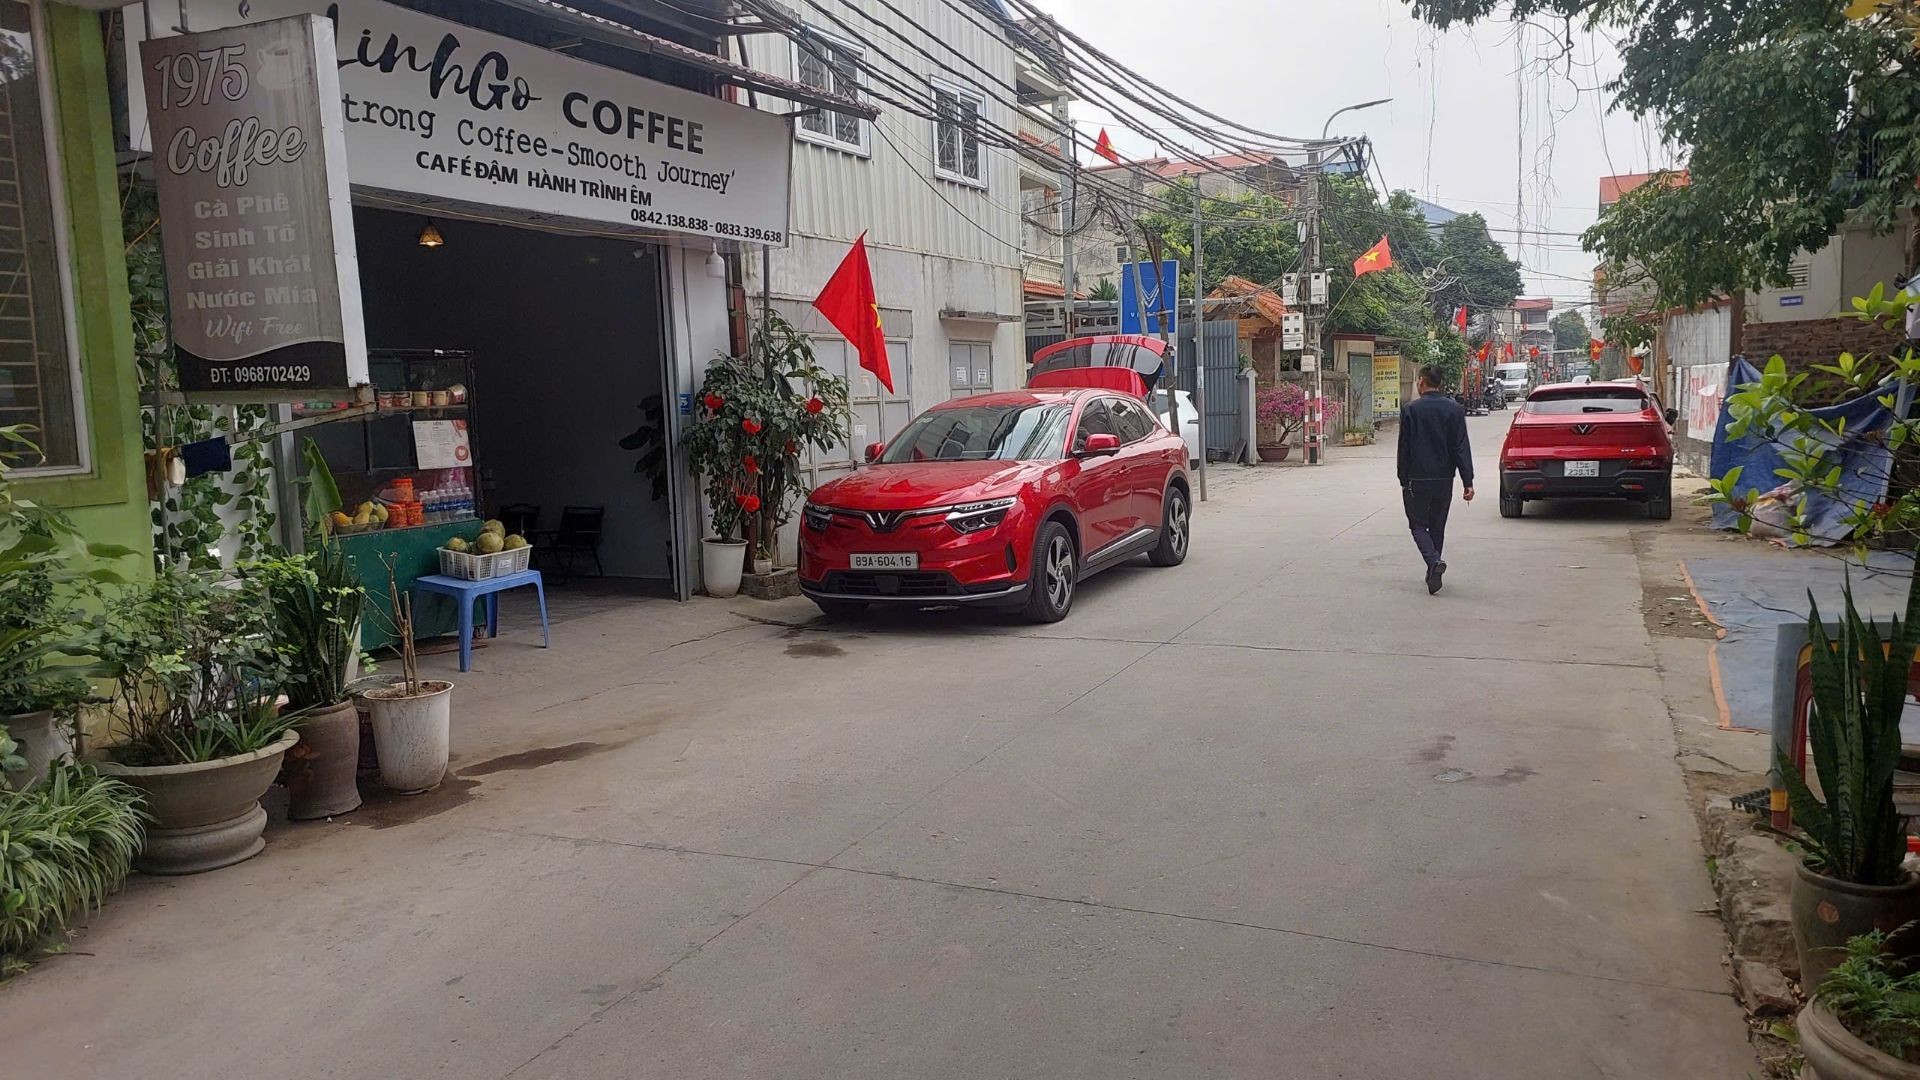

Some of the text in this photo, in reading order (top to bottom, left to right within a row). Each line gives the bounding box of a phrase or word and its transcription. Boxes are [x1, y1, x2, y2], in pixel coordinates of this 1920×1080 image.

[153, 43, 249, 111] 1975
[341, 93, 436, 139] trong
[562, 92, 704, 155] COFFEE
[167, 116, 307, 188] Coffee
[415, 151, 652, 207] CAFÉ ĐẬM HÀNH TRÌNH ÊM
[194, 193, 290, 219] Cà Phê
[195, 221, 297, 249] Sinh Tố
[187, 258, 240, 280] Giải
[186, 289, 256, 309] Nước
[206, 314, 303, 344] Wifi Free
[211, 365, 311, 384] ĐT: 0968702429
[855, 556, 912, 567] 89A-604.16
